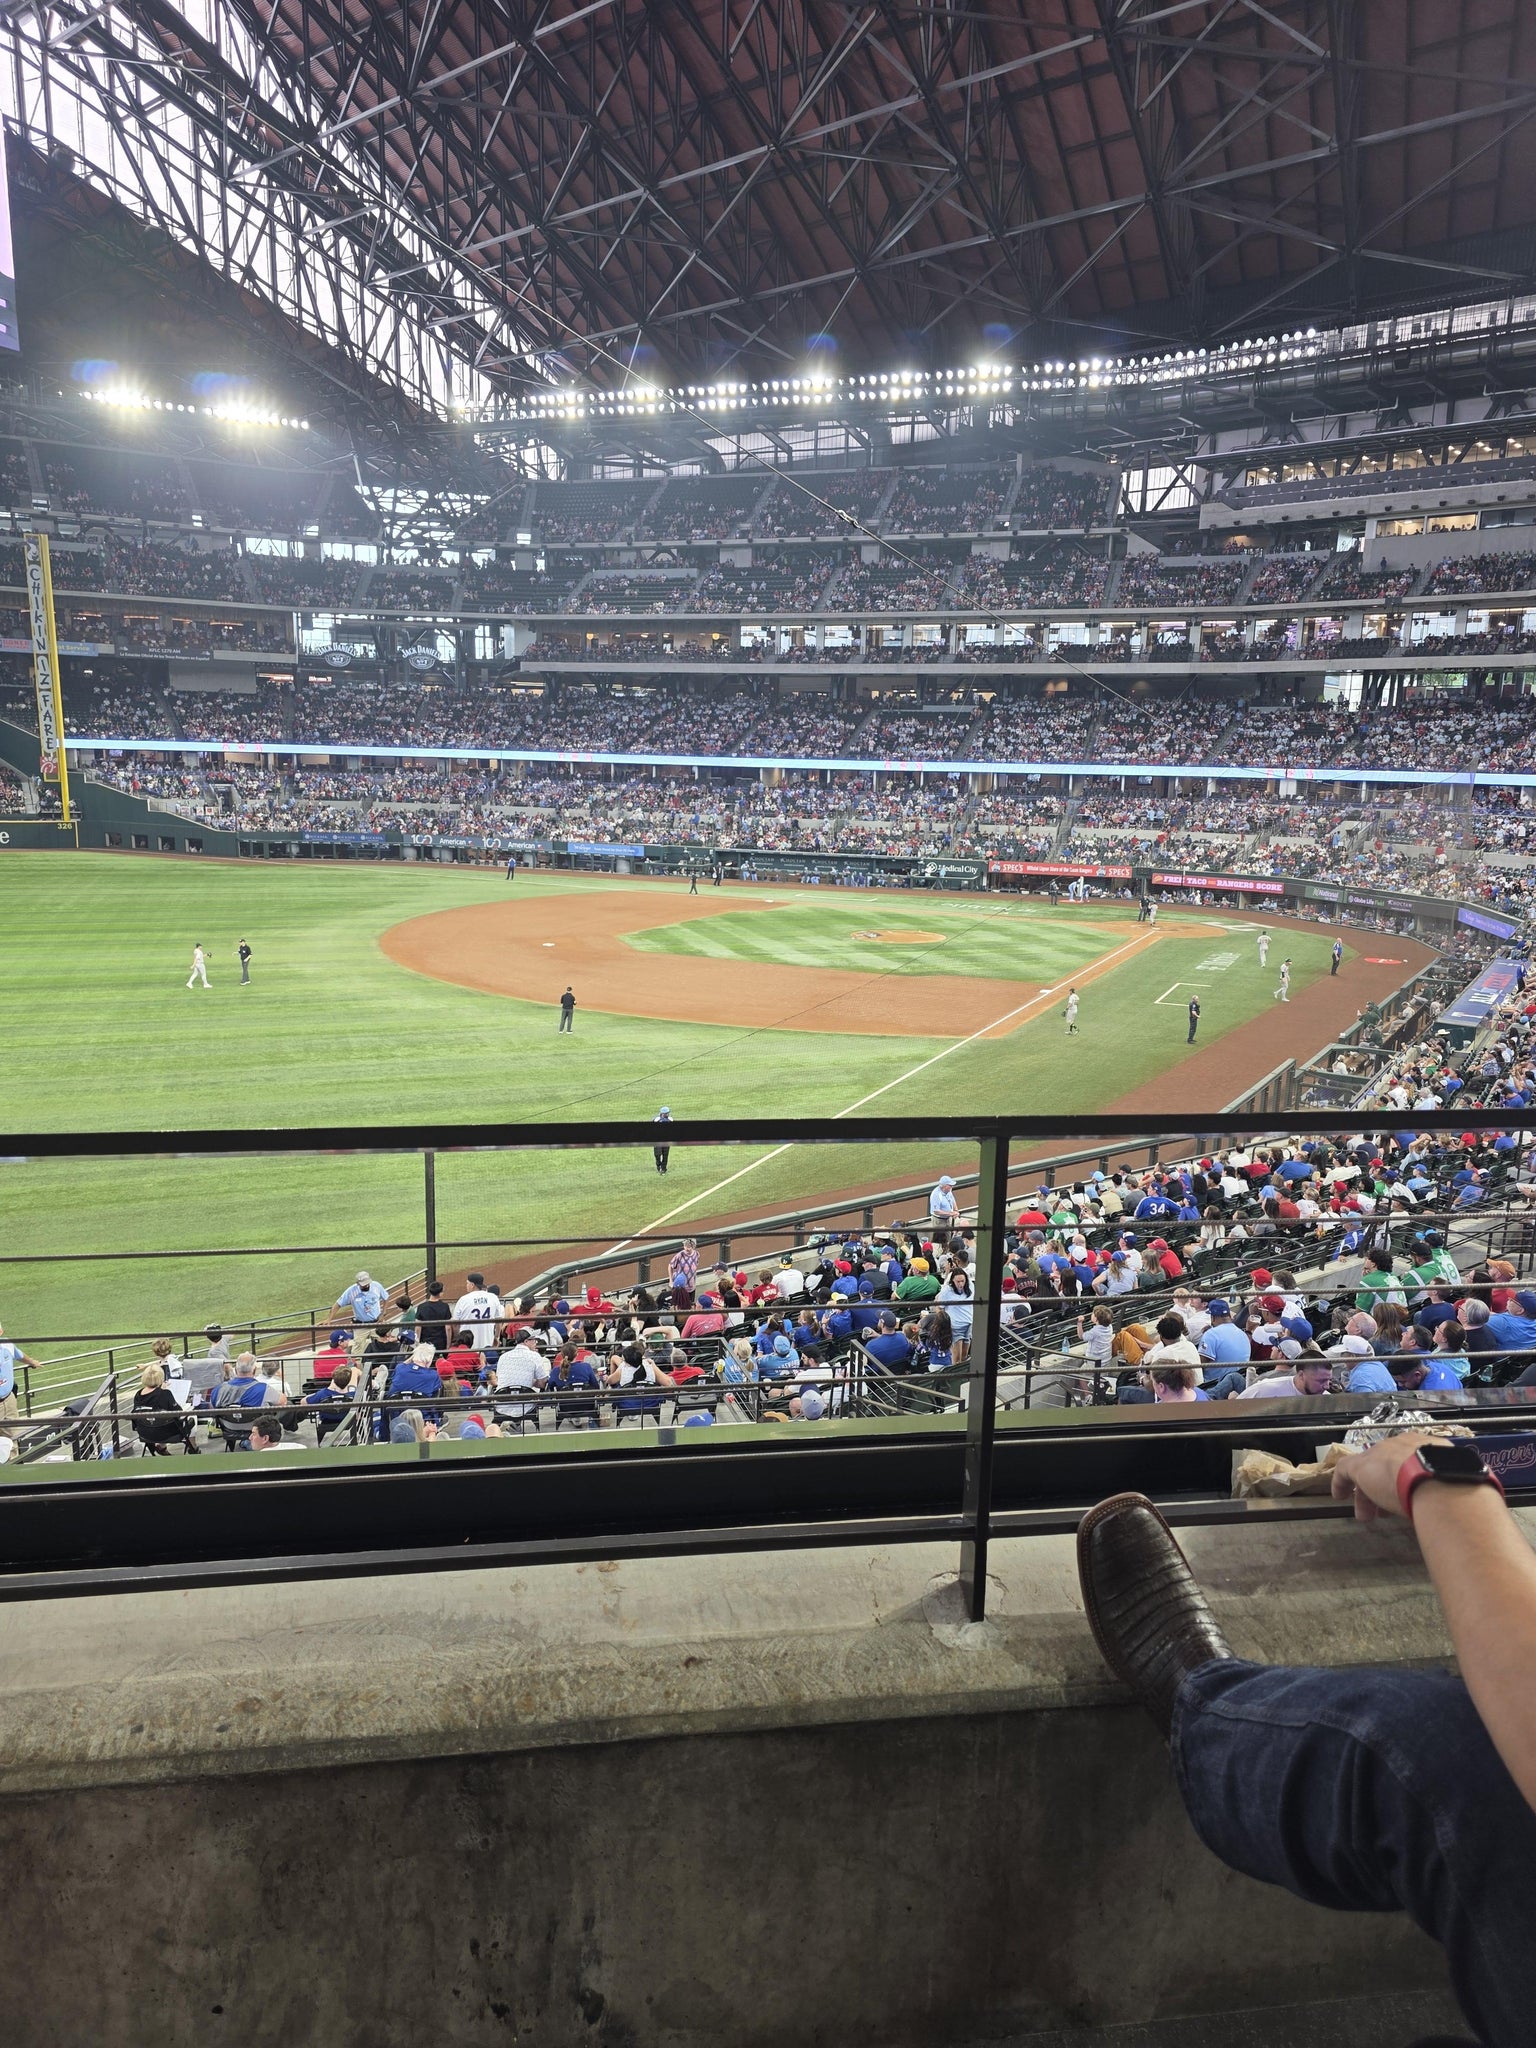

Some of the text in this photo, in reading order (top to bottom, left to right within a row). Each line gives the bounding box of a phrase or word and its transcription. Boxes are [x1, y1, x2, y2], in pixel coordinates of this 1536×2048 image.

[317, 645, 332, 656] JACK
[401, 646, 417, 658] JACK
[29, 567, 55, 750] CHIKIN IZ FARE
[440, 837, 466, 846] American
[508, 841, 536, 850] American
[964, 865, 978, 875] City
[1003, 863, 1024, 871] SPEC'S
[1108, 867, 1130, 875] SPEC'S
[1163, 875, 1185, 884] FREE
[1186, 877, 1207, 885] TACO
[1216, 880, 1254, 889] RANGERS
[1256, 883, 1282, 891] SCORE
[1319, 890, 1339, 898] National
[1354, 896, 1366, 904] Globe
[1150, 1203, 1165, 1215] 34
[471, 1307, 491, 1319] 34
